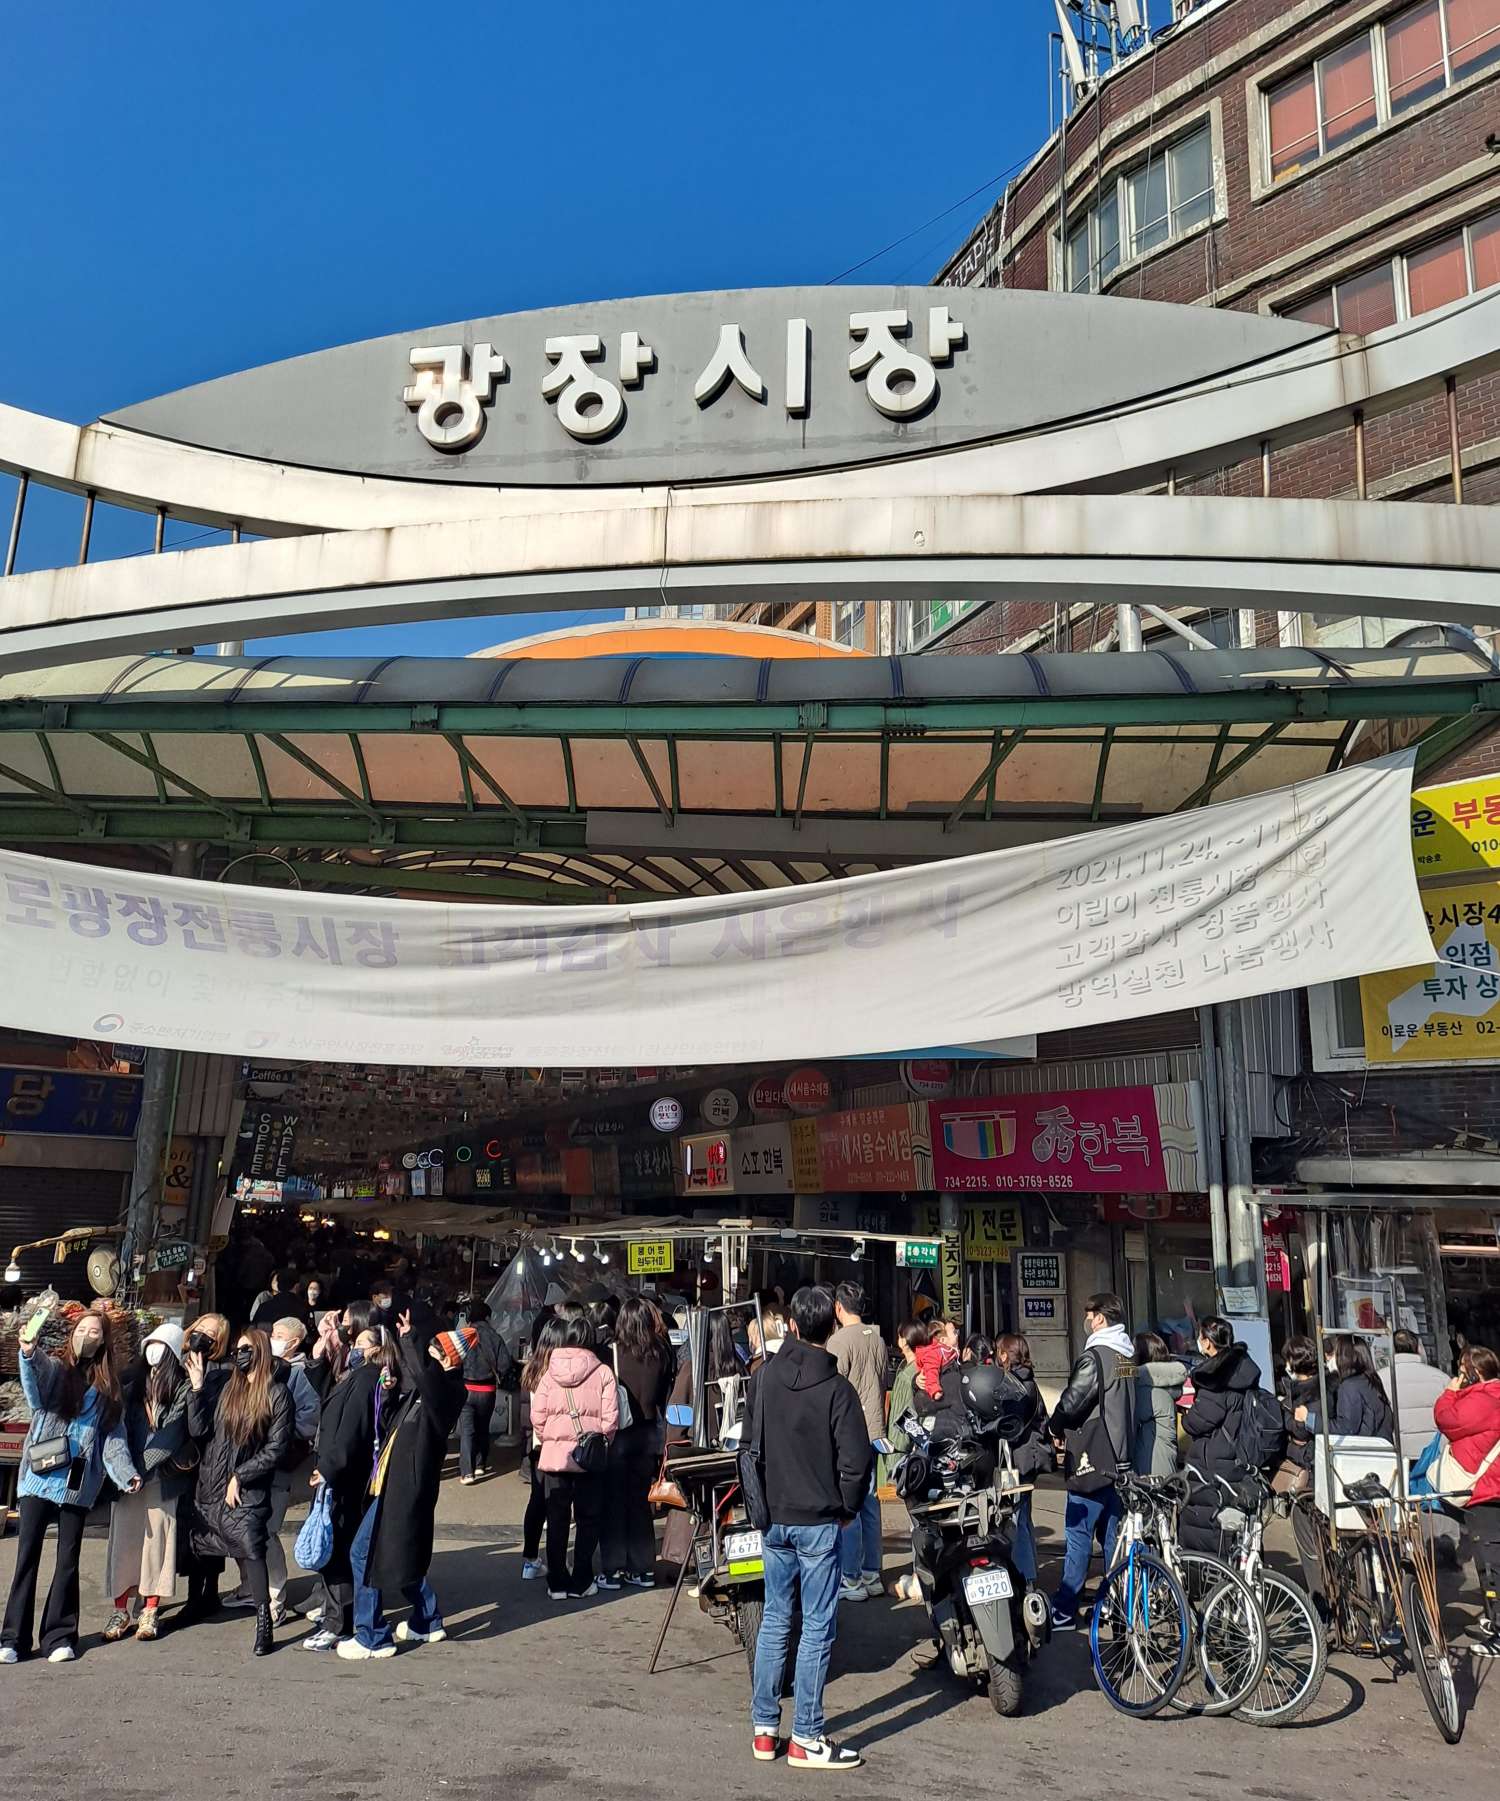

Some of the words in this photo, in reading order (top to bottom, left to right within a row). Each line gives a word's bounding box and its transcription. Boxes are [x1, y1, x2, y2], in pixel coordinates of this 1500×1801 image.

[403, 306, 965, 450] 광장시장
[1055, 891, 1138, 929] 어린이
[1423, 976, 1468, 1003] 투자
[1382, 1023, 1419, 1038] 이로운
[1423, 1021, 1463, 1037] 부동산
[250, 1113, 272, 1175] COFFEE
[275, 1115, 299, 1178] WAFFLE
[741, 1150, 761, 1174] 소호
[763, 1147, 784, 1175] 한복
[996, 1174, 1073, 1188] 010-3769-8526
[982, 1208, 1017, 1241] 전문
[944, 1234, 961, 1279] 보자기
[977, 1581, 1008, 1598] 9220
